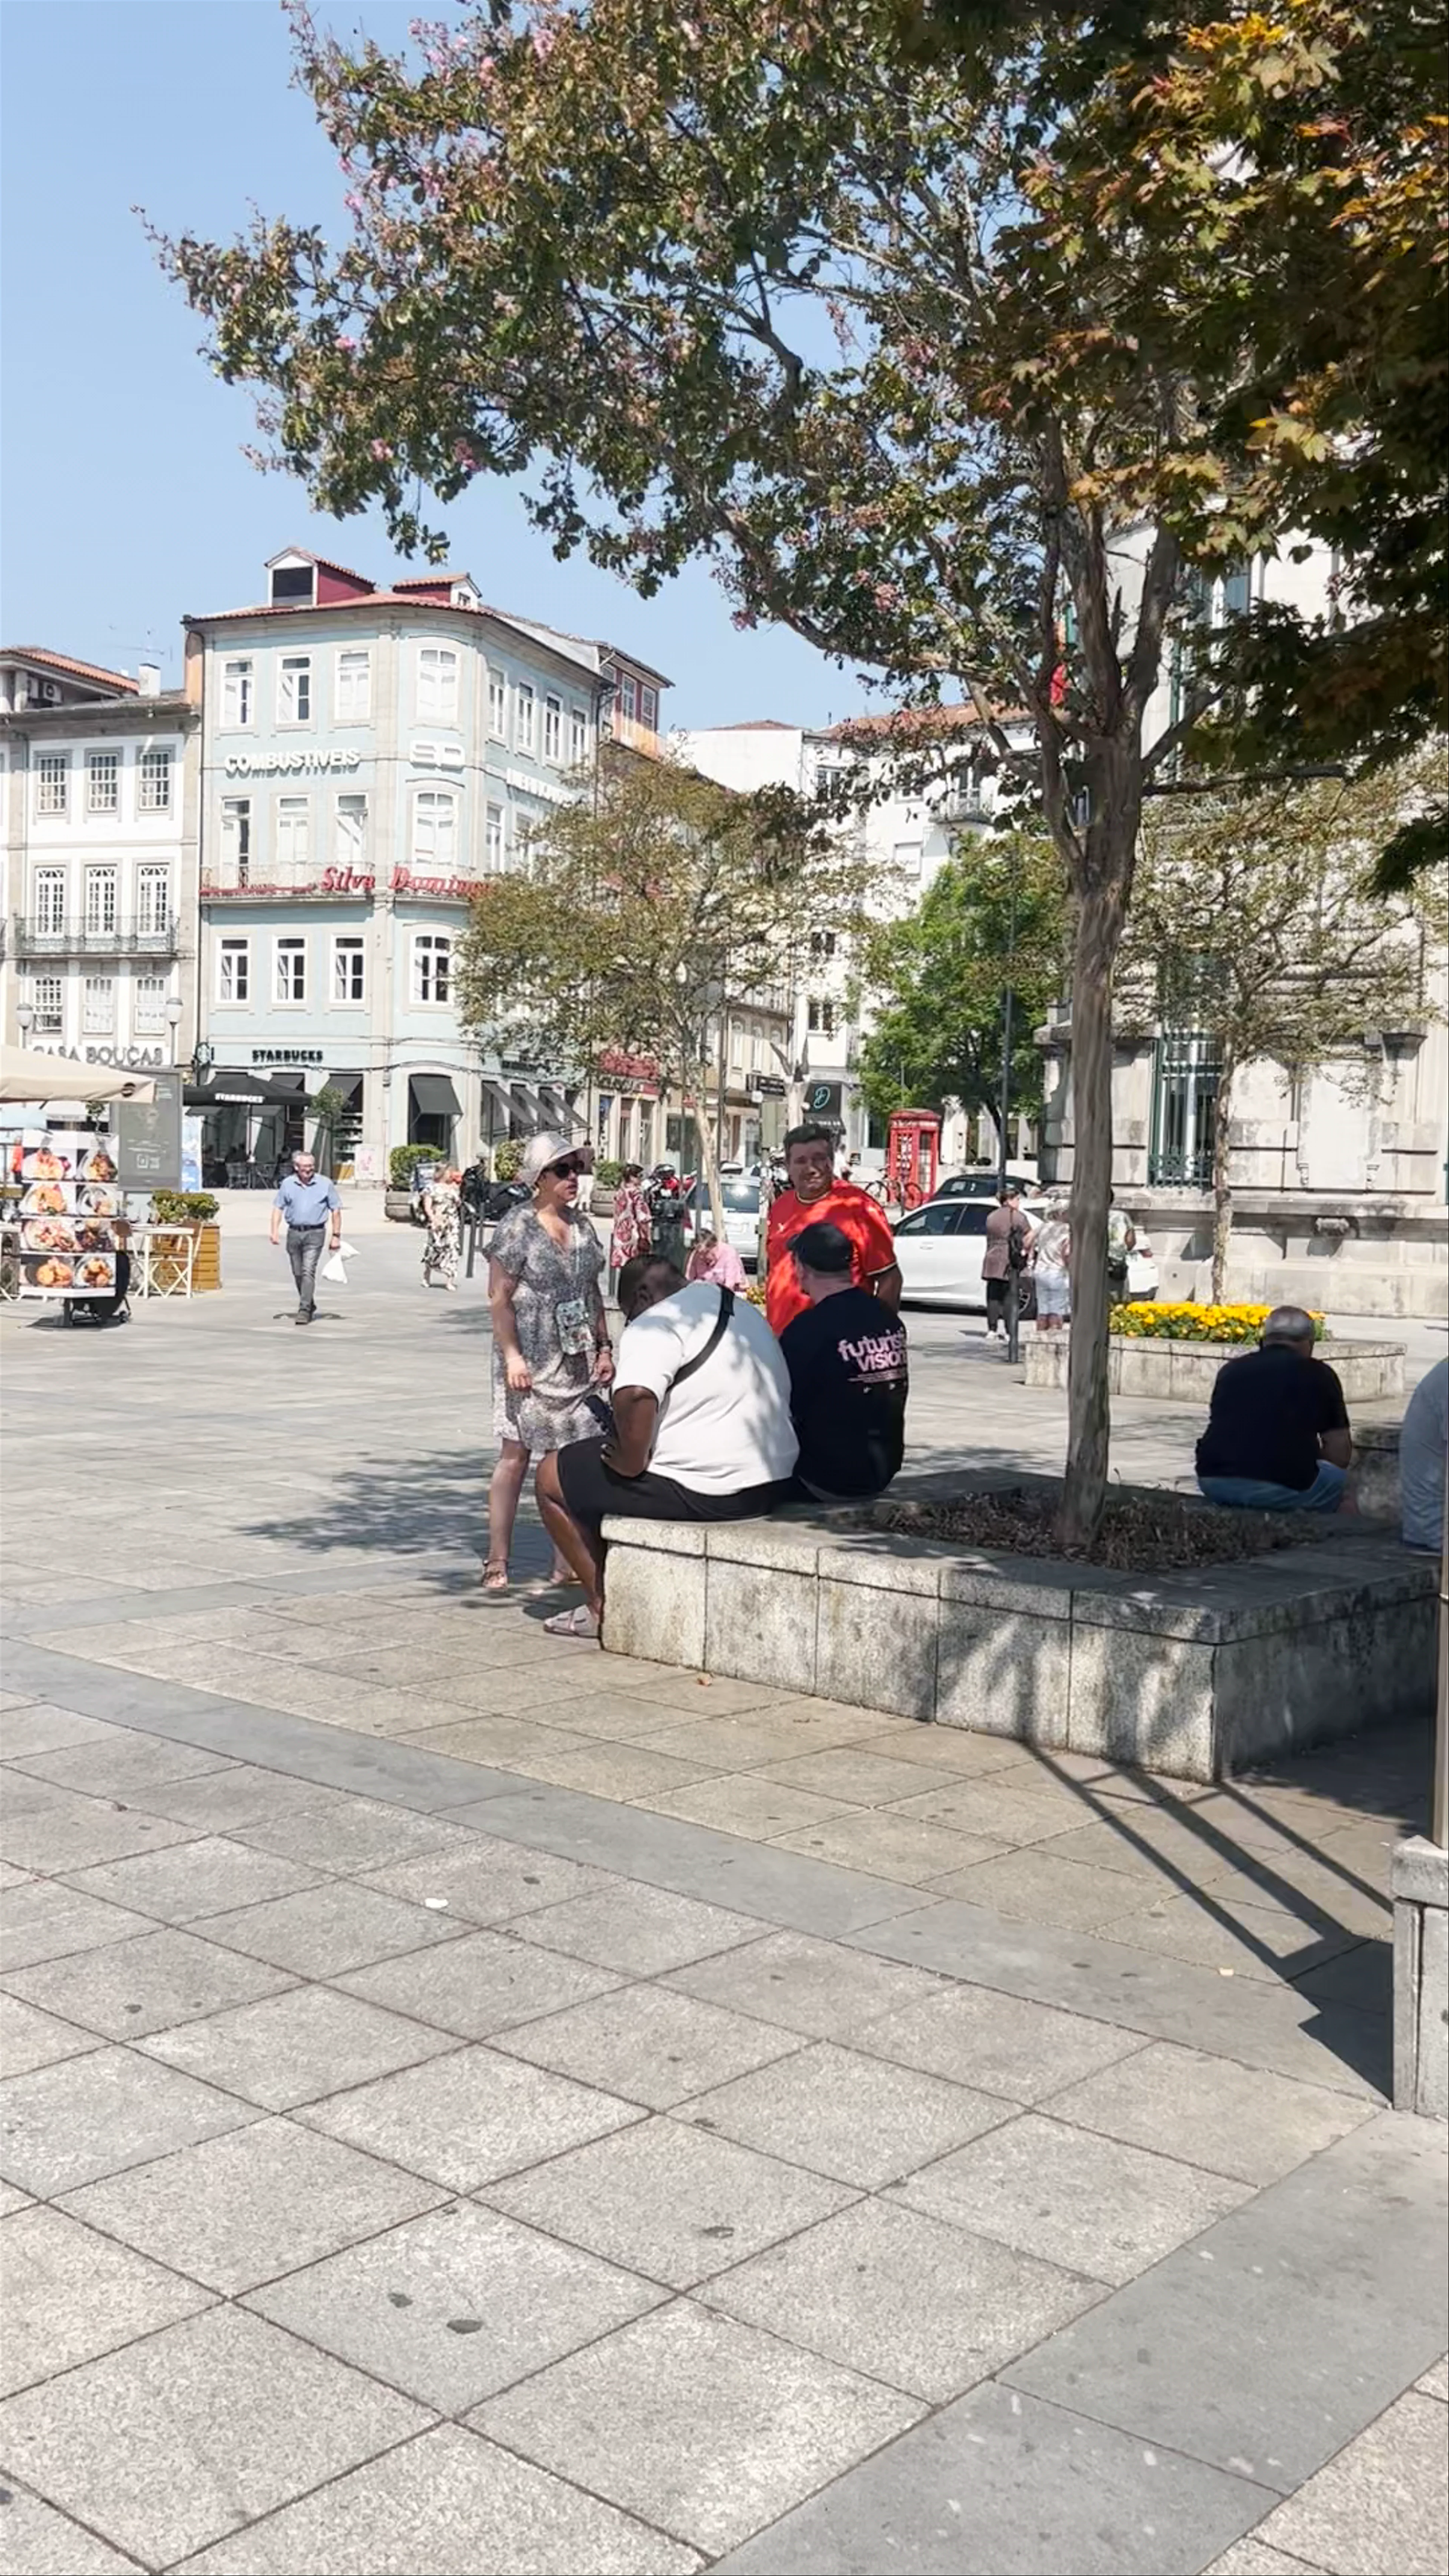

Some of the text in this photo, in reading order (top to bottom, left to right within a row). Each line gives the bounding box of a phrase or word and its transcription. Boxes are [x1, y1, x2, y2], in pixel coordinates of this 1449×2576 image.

[320, 866, 375, 891] Silva
[86, 1046, 163, 1066] BOUÇAS
[252, 1049, 323, 1062] STARBUCKS
